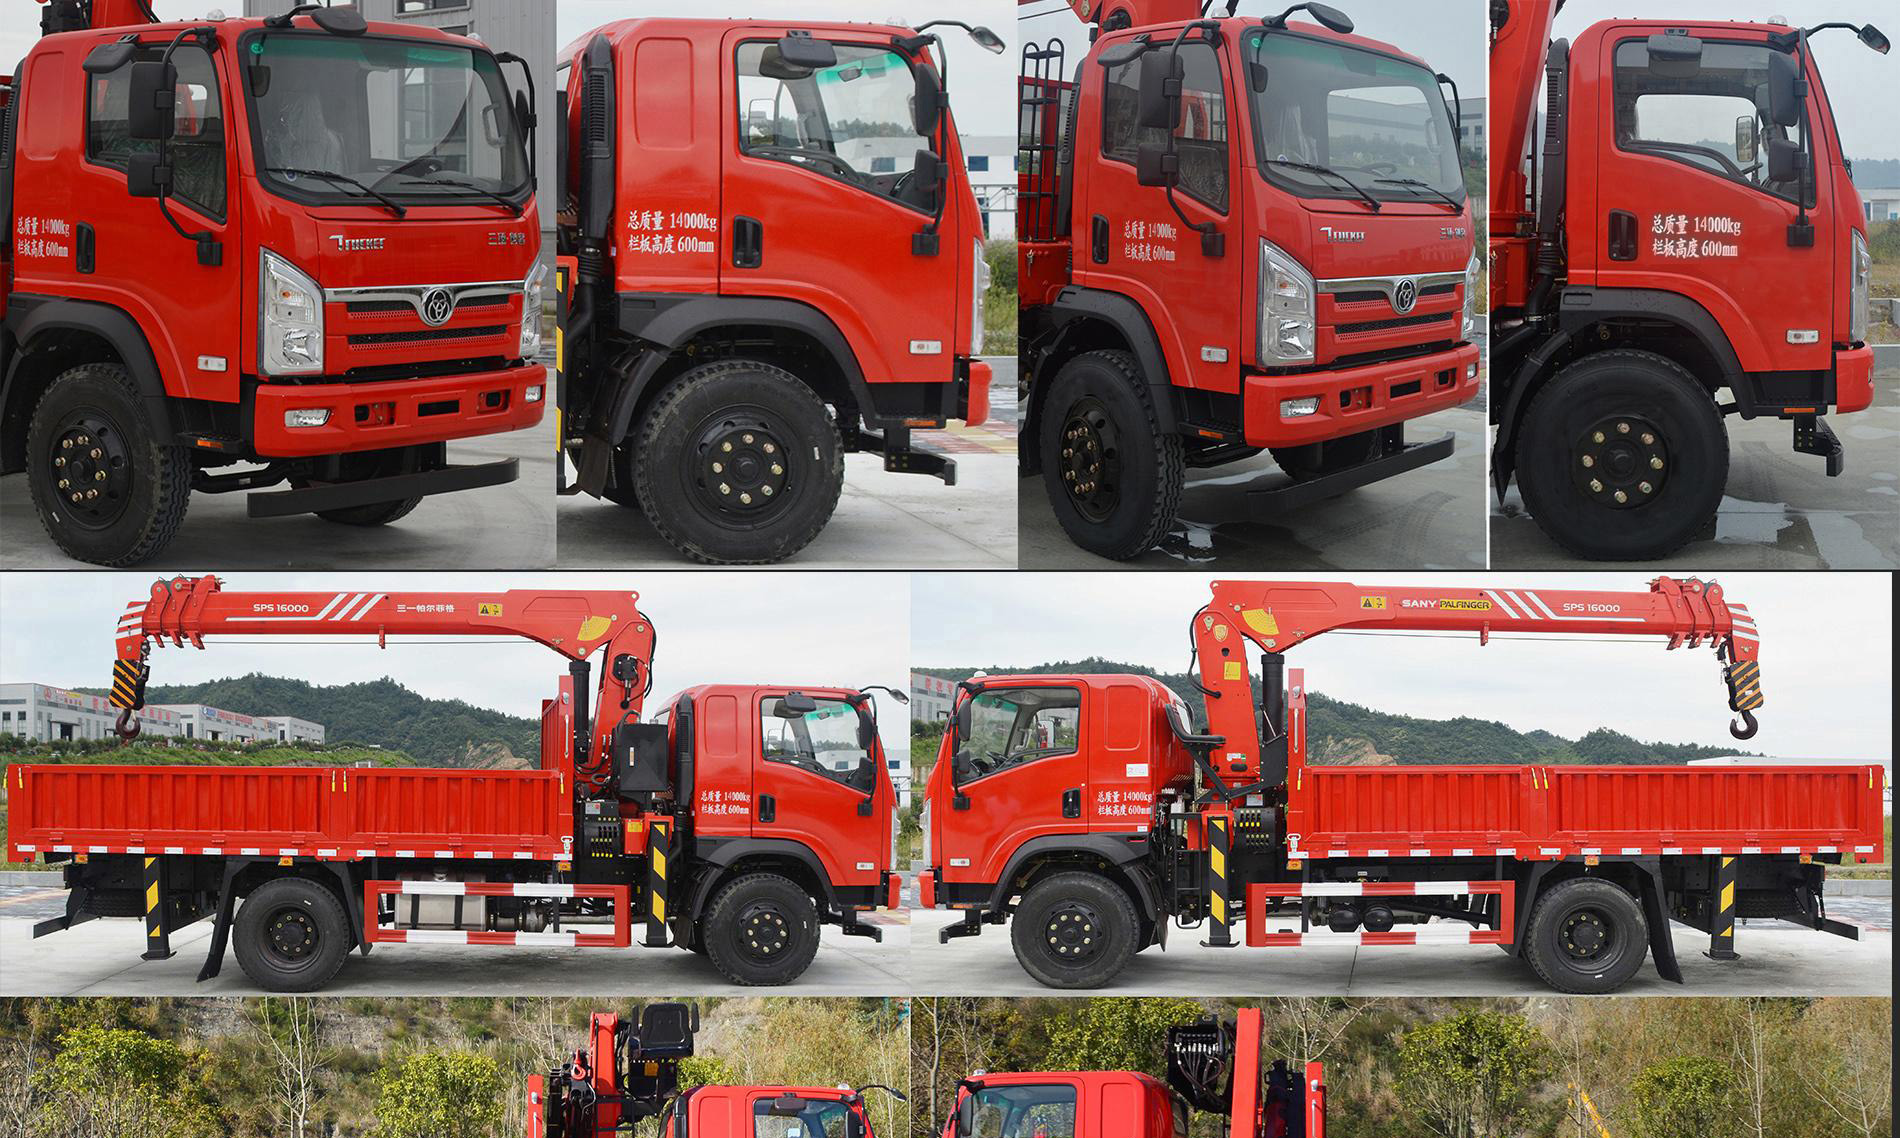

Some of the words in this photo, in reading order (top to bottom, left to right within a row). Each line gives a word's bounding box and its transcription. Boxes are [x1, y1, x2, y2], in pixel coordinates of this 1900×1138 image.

[17, 216, 38, 235] 总质量
[41, 218, 70, 237] 14000kg
[628, 210, 664, 231] 总质量
[670, 211, 717, 232] 14000kg
[1652, 214, 1688, 235] 总质量
[1694, 216, 1741, 236] 14000kg
[1124, 220, 1145, 239] 总质量
[1148, 222, 1177, 241] 14000kg
[46, 241, 69, 257] 600mm
[628, 234, 675, 255] 栏板高度
[678, 236, 714, 253] 600mm
[1153, 245, 1175, 261] 600mm
[1652, 238, 1699, 259] 栏板高度
[1701, 240, 1738, 257] 600mm
[253, 604, 274, 612] SPS
[276, 604, 309, 613] 16000
[397, 604, 455, 613] 三一帕尔菲格
[1402, 599, 1437, 608] SANY
[1440, 600, 1490, 609] PALFINGER
[1563, 603, 1585, 612] SPS
[1587, 604, 1621, 612] 16000
